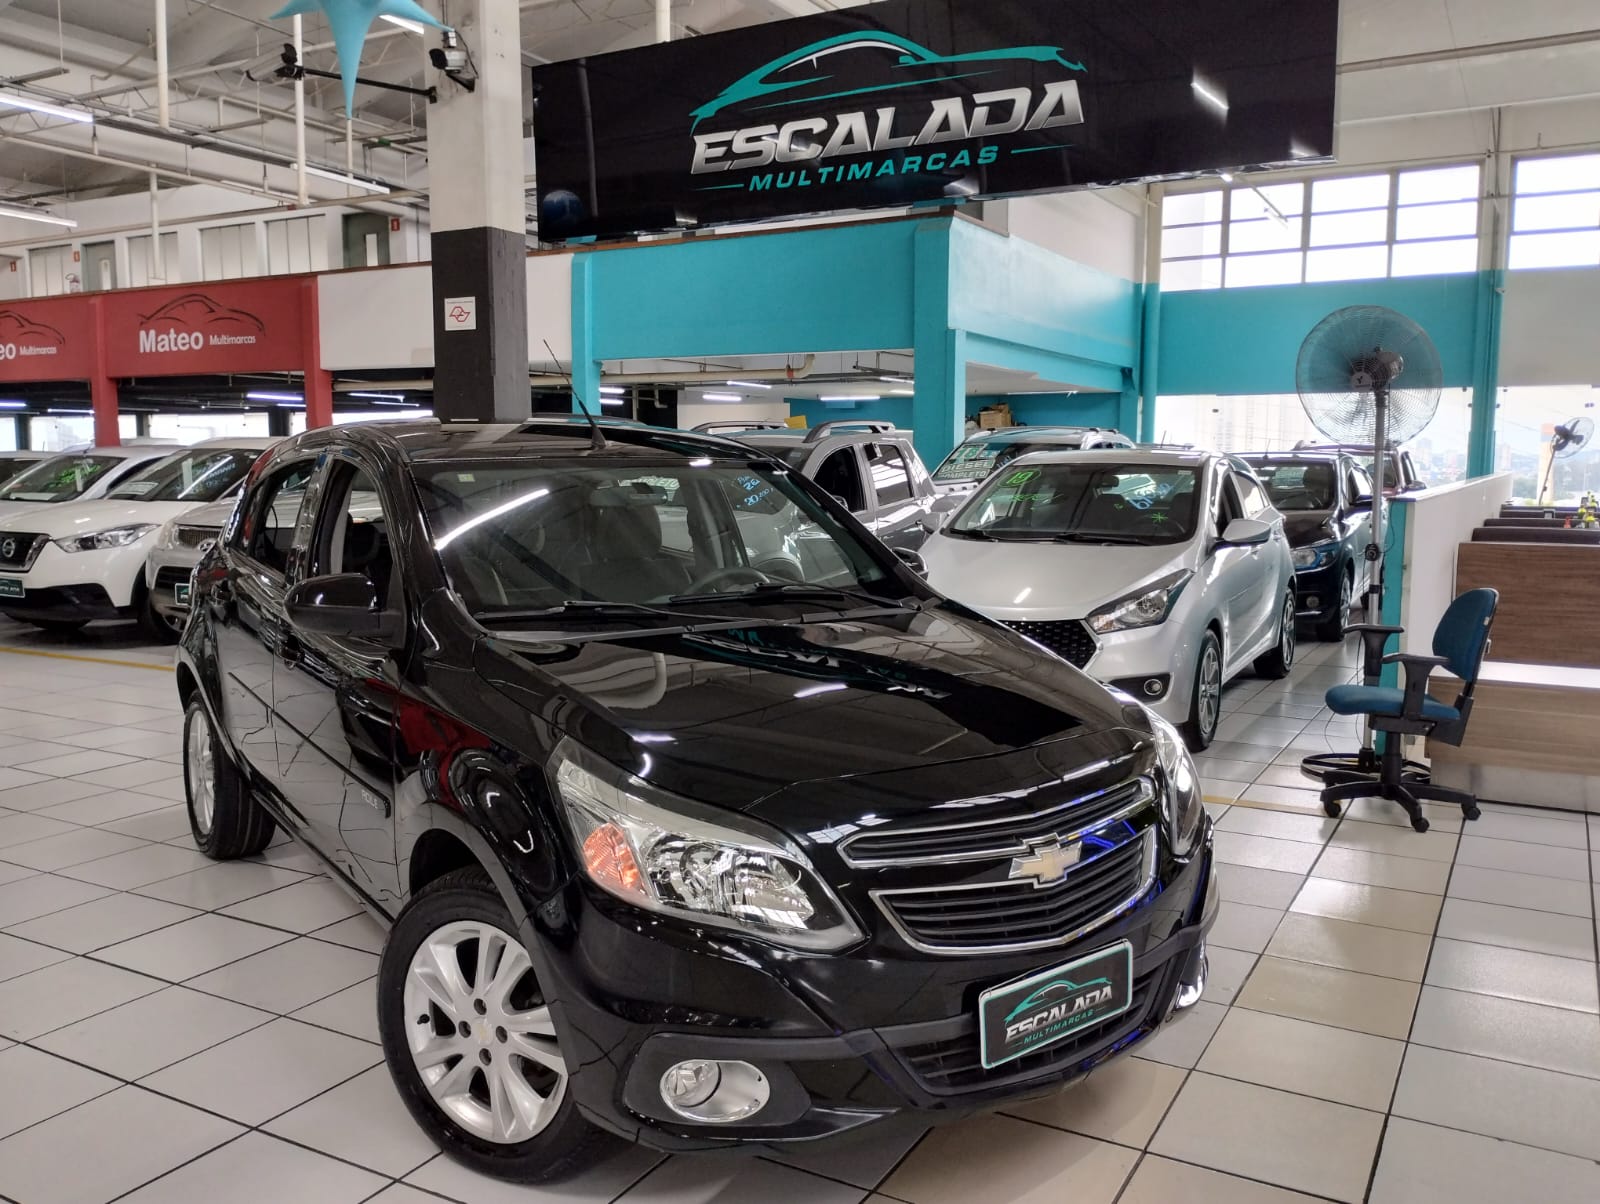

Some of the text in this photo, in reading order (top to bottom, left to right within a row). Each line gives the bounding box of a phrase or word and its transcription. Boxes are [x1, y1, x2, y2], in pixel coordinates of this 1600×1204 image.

[691, 80, 1084, 174] ESCALADA
[748, 145, 999, 192] MULTIMARCAS
[138, 328, 256, 354] Mateo Multimarcas
[941, 461, 994, 473] DIESEL
[1005, 986, 1112, 1042] ESCALADA
[1023, 1009, 1094, 1044] MULTIMARCAS
